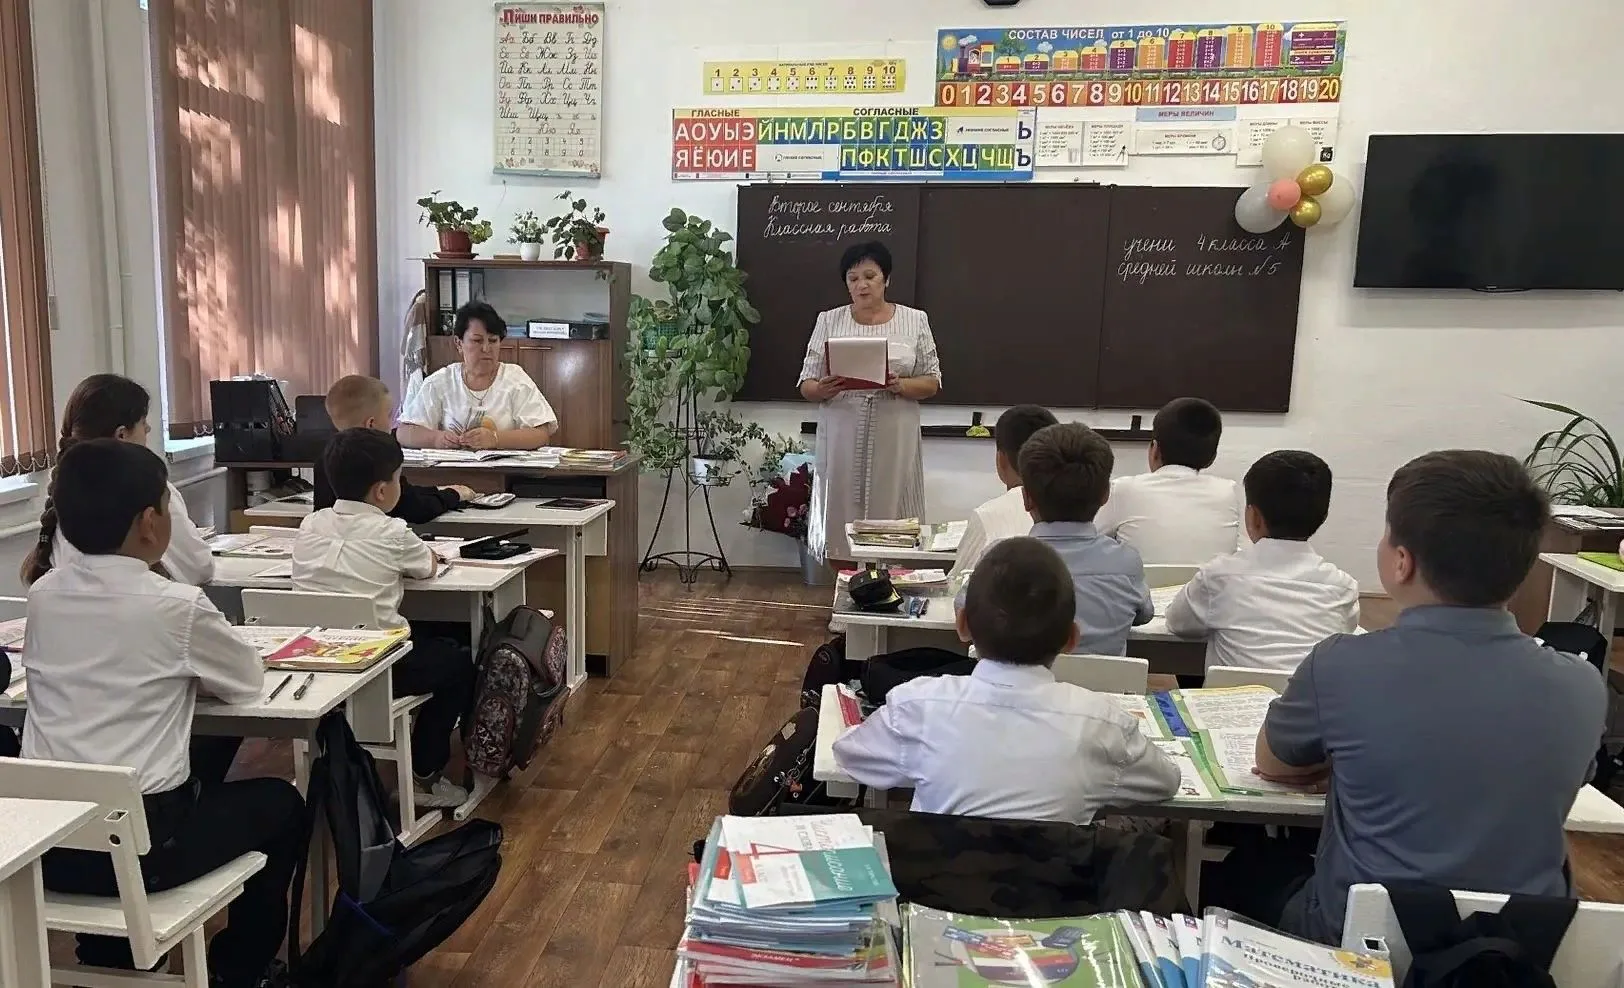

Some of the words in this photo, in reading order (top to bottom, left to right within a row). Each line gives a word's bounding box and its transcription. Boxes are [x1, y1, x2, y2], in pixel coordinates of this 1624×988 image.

[502, 9, 538, 24] ПИШИ
[539, 13, 600, 24] ПРАВИЛЬНО
[1008, 29, 1058, 40] СОСТАВ
[1061, 29, 1104, 40] ЧИСЕЛ
[1128, 29, 1133, 38] 1
[1136, 30, 1153, 40] до
[1158, 28, 1169, 38] 10
[771, 68, 777, 76] 4
[790, 68, 796, 76] 5
[809, 67, 815, 75] 6
[847, 67, 854, 75] 8
[867, 66, 873, 74] 9
[884, 66, 896, 74] 10
[942, 85, 954, 104] 0
[961, 86, 970, 104] 1
[978, 85, 991, 104] 2
[996, 85, 1008, 104] 3
[1013, 85, 1026, 103] 4
[1033, 85, 1046, 103] 5
[1052, 84, 1064, 103] 6
[1072, 84, 1084, 103] 7
[1090, 84, 1103, 103] 8
[1108, 84, 1121, 103] 9
[1125, 83, 1142, 103] 10
[1145, 83, 1160, 102] 11
[1164, 83, 1181, 102] 12
[1183, 82, 1200, 102] 13
[1203, 82, 1220, 102] 14
[1223, 81, 1240, 101] 15
[1241, 80, 1259, 101] 16
[1261, 80, 1278, 101] 17
[1281, 80, 1298, 100] 18
[1300, 79, 1317, 100] 19
[1320, 79, 1339, 100] 20
[691, 109, 740, 117] ГЛАСНЫЕ
[853, 108, 919, 116] СОГЛАСНЫЕ
[1018, 120, 1032, 140] Ь
[1016, 148, 1032, 167] Ъ
[768, 194, 822, 220] Второе
[828, 195, 894, 218] сентября
[764, 215, 835, 238] Классная
[836, 216, 892, 240] работа
[1123, 238, 1176, 260] учени
[1197, 234, 1204, 250] 4
[1208, 238, 1268, 251] класса
[1272, 232, 1292, 250] А
[1117, 259, 1177, 284] средней
[1186, 262, 1245, 276] школы
[1221, 935, 1380, 988] Математика
